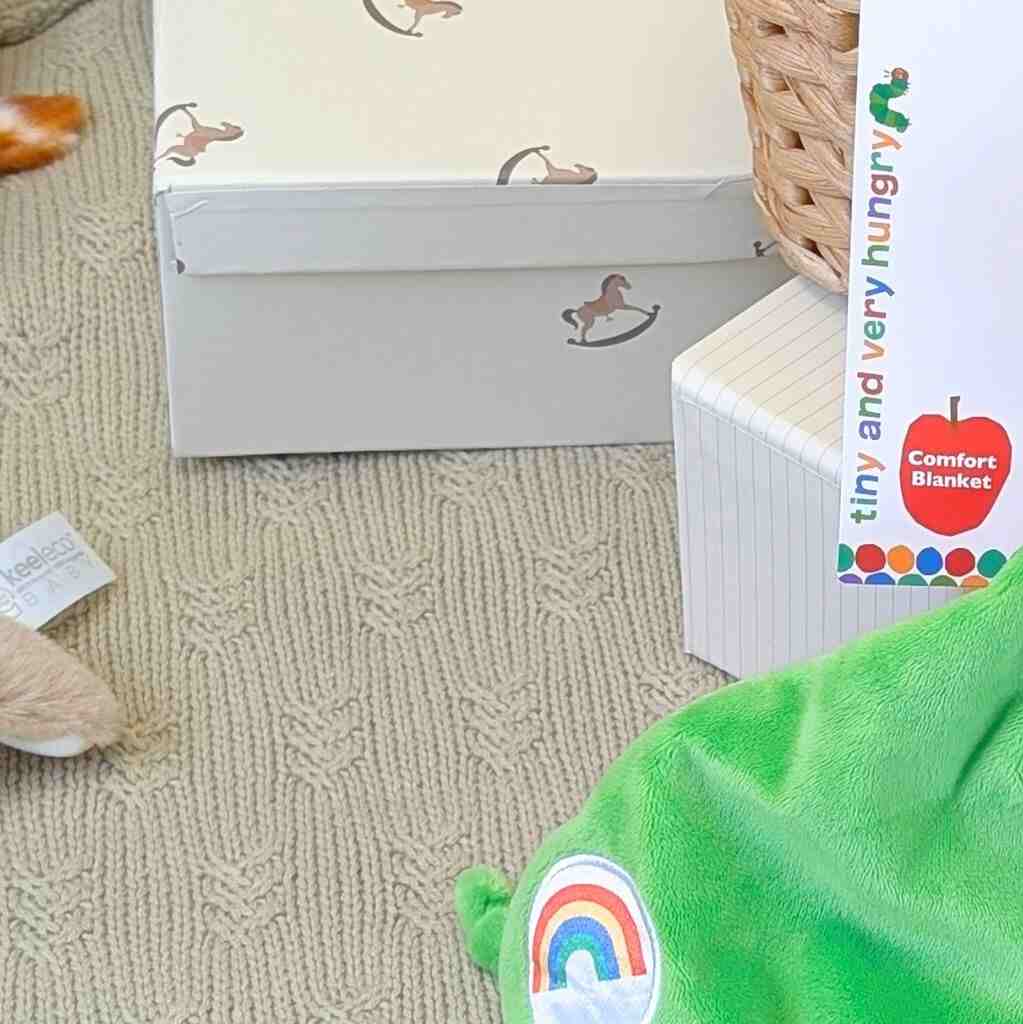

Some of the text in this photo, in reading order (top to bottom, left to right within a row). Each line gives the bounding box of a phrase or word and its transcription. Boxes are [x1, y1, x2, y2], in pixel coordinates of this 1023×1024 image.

[850, 129, 903, 524] tiny and very hungry
[908, 450, 998, 470] Comfort
[911, 471, 992, 489] Blanket
